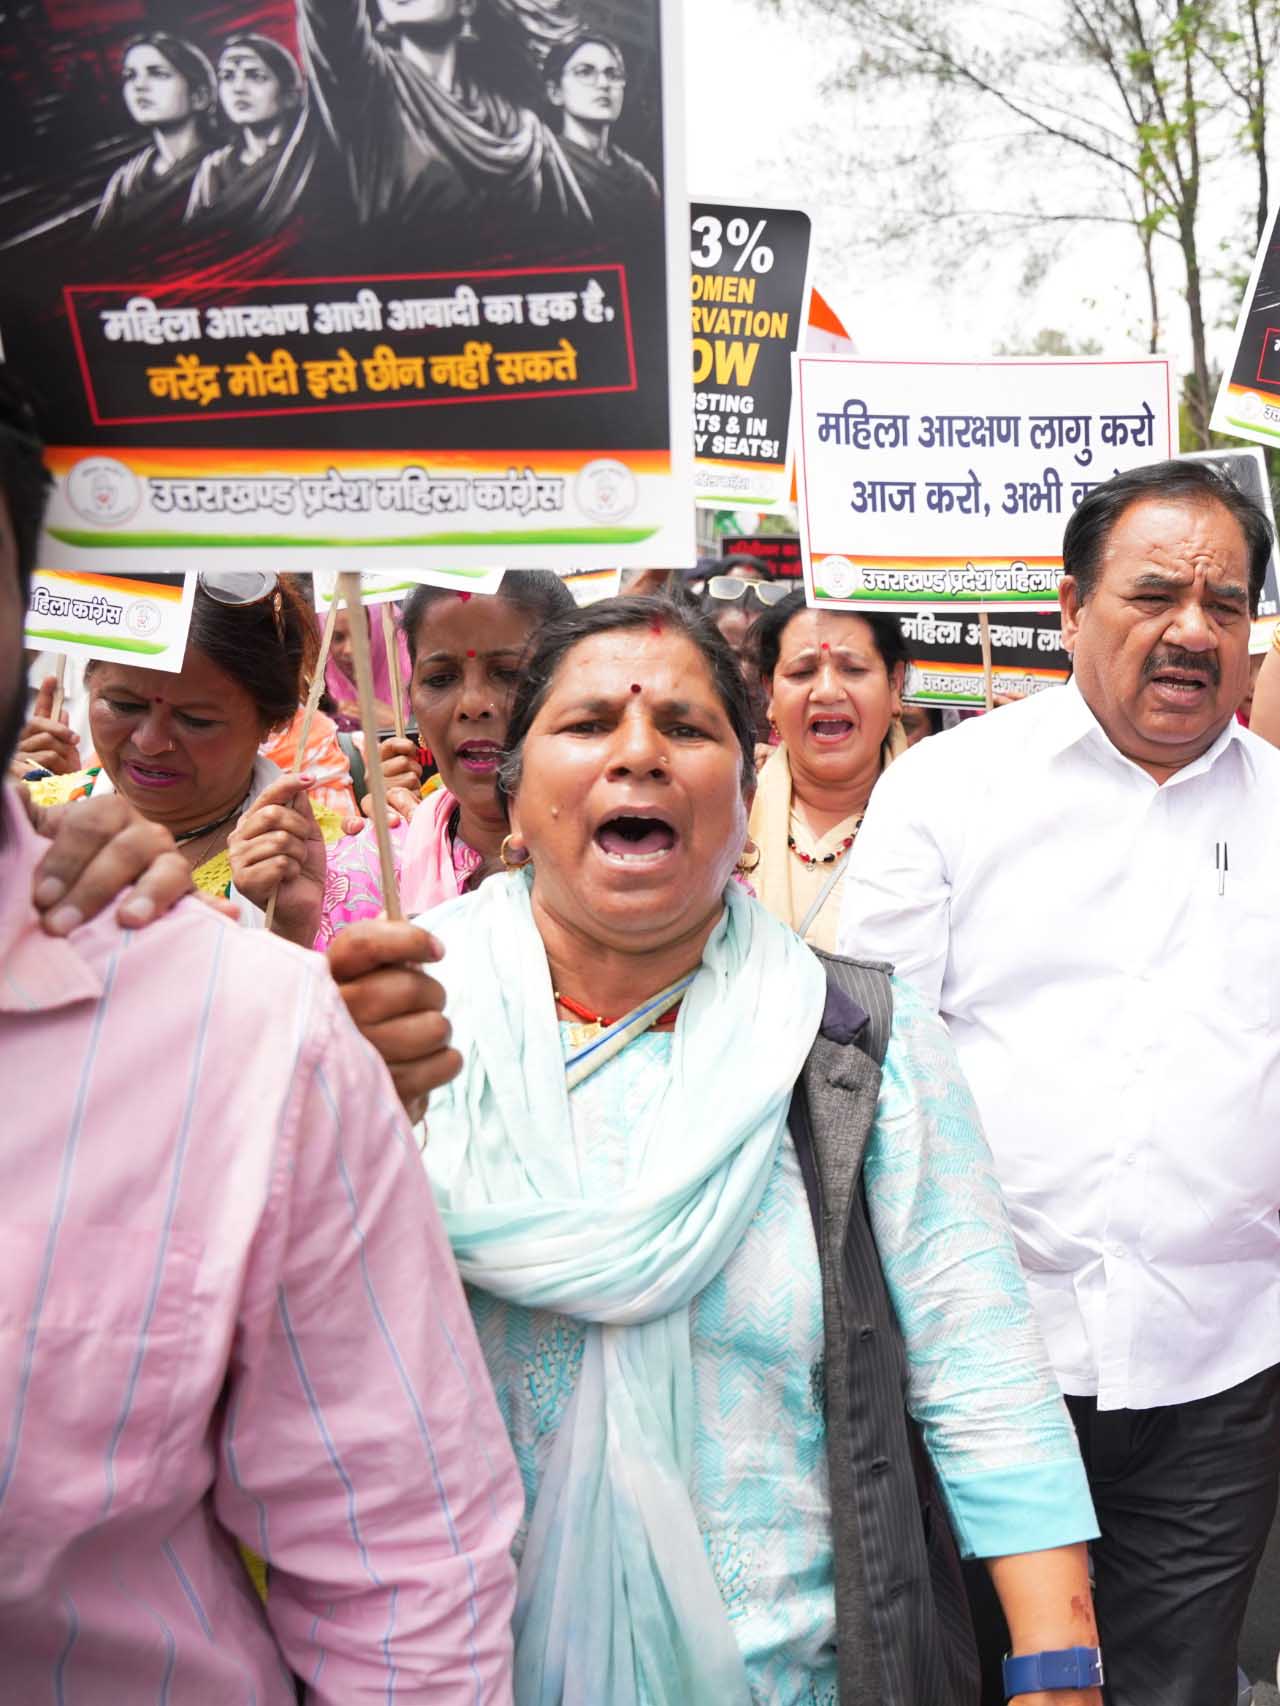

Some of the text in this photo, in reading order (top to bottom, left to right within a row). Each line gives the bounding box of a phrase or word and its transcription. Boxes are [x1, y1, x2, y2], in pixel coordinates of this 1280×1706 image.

[690, 216, 774, 273] 3%
[690, 274, 756, 304] OMEN
[99, 296, 201, 345] महिला
[205, 304, 310, 340] आरक्षण
[313, 288, 383, 335] आधी
[482, 294, 523, 325] का
[526, 292, 577, 326] हक
[580, 278, 615, 323] है,
[691, 306, 789, 338] RVATION
[146, 338, 578, 406] नरेंद्र मोदी इसे छीन नहीं सकते
[691, 338, 760, 387] OW
[692, 392, 754, 414] STING
[726, 416, 740, 434] &
[746, 417, 768, 436] IN
[817, 398, 1156, 467] महिला आरक्षण लागु करो
[712, 435, 780, 458] SEATS!
[149, 464, 564, 518] उत्तराखण्ड प्रदेश महिला कांग्रेस
[850, 479, 916, 514] आज
[925, 468, 990, 517] करो,
[1001, 467, 1063, 514] अभी
[862, 568, 946, 593] उत्तराखण्ड
[948, 561, 994, 596] प्रदेश
[994, 561, 1051, 593] महिला
[31, 587, 123, 625] हिला कांग्रेस
[900, 611, 962, 645] महिला
